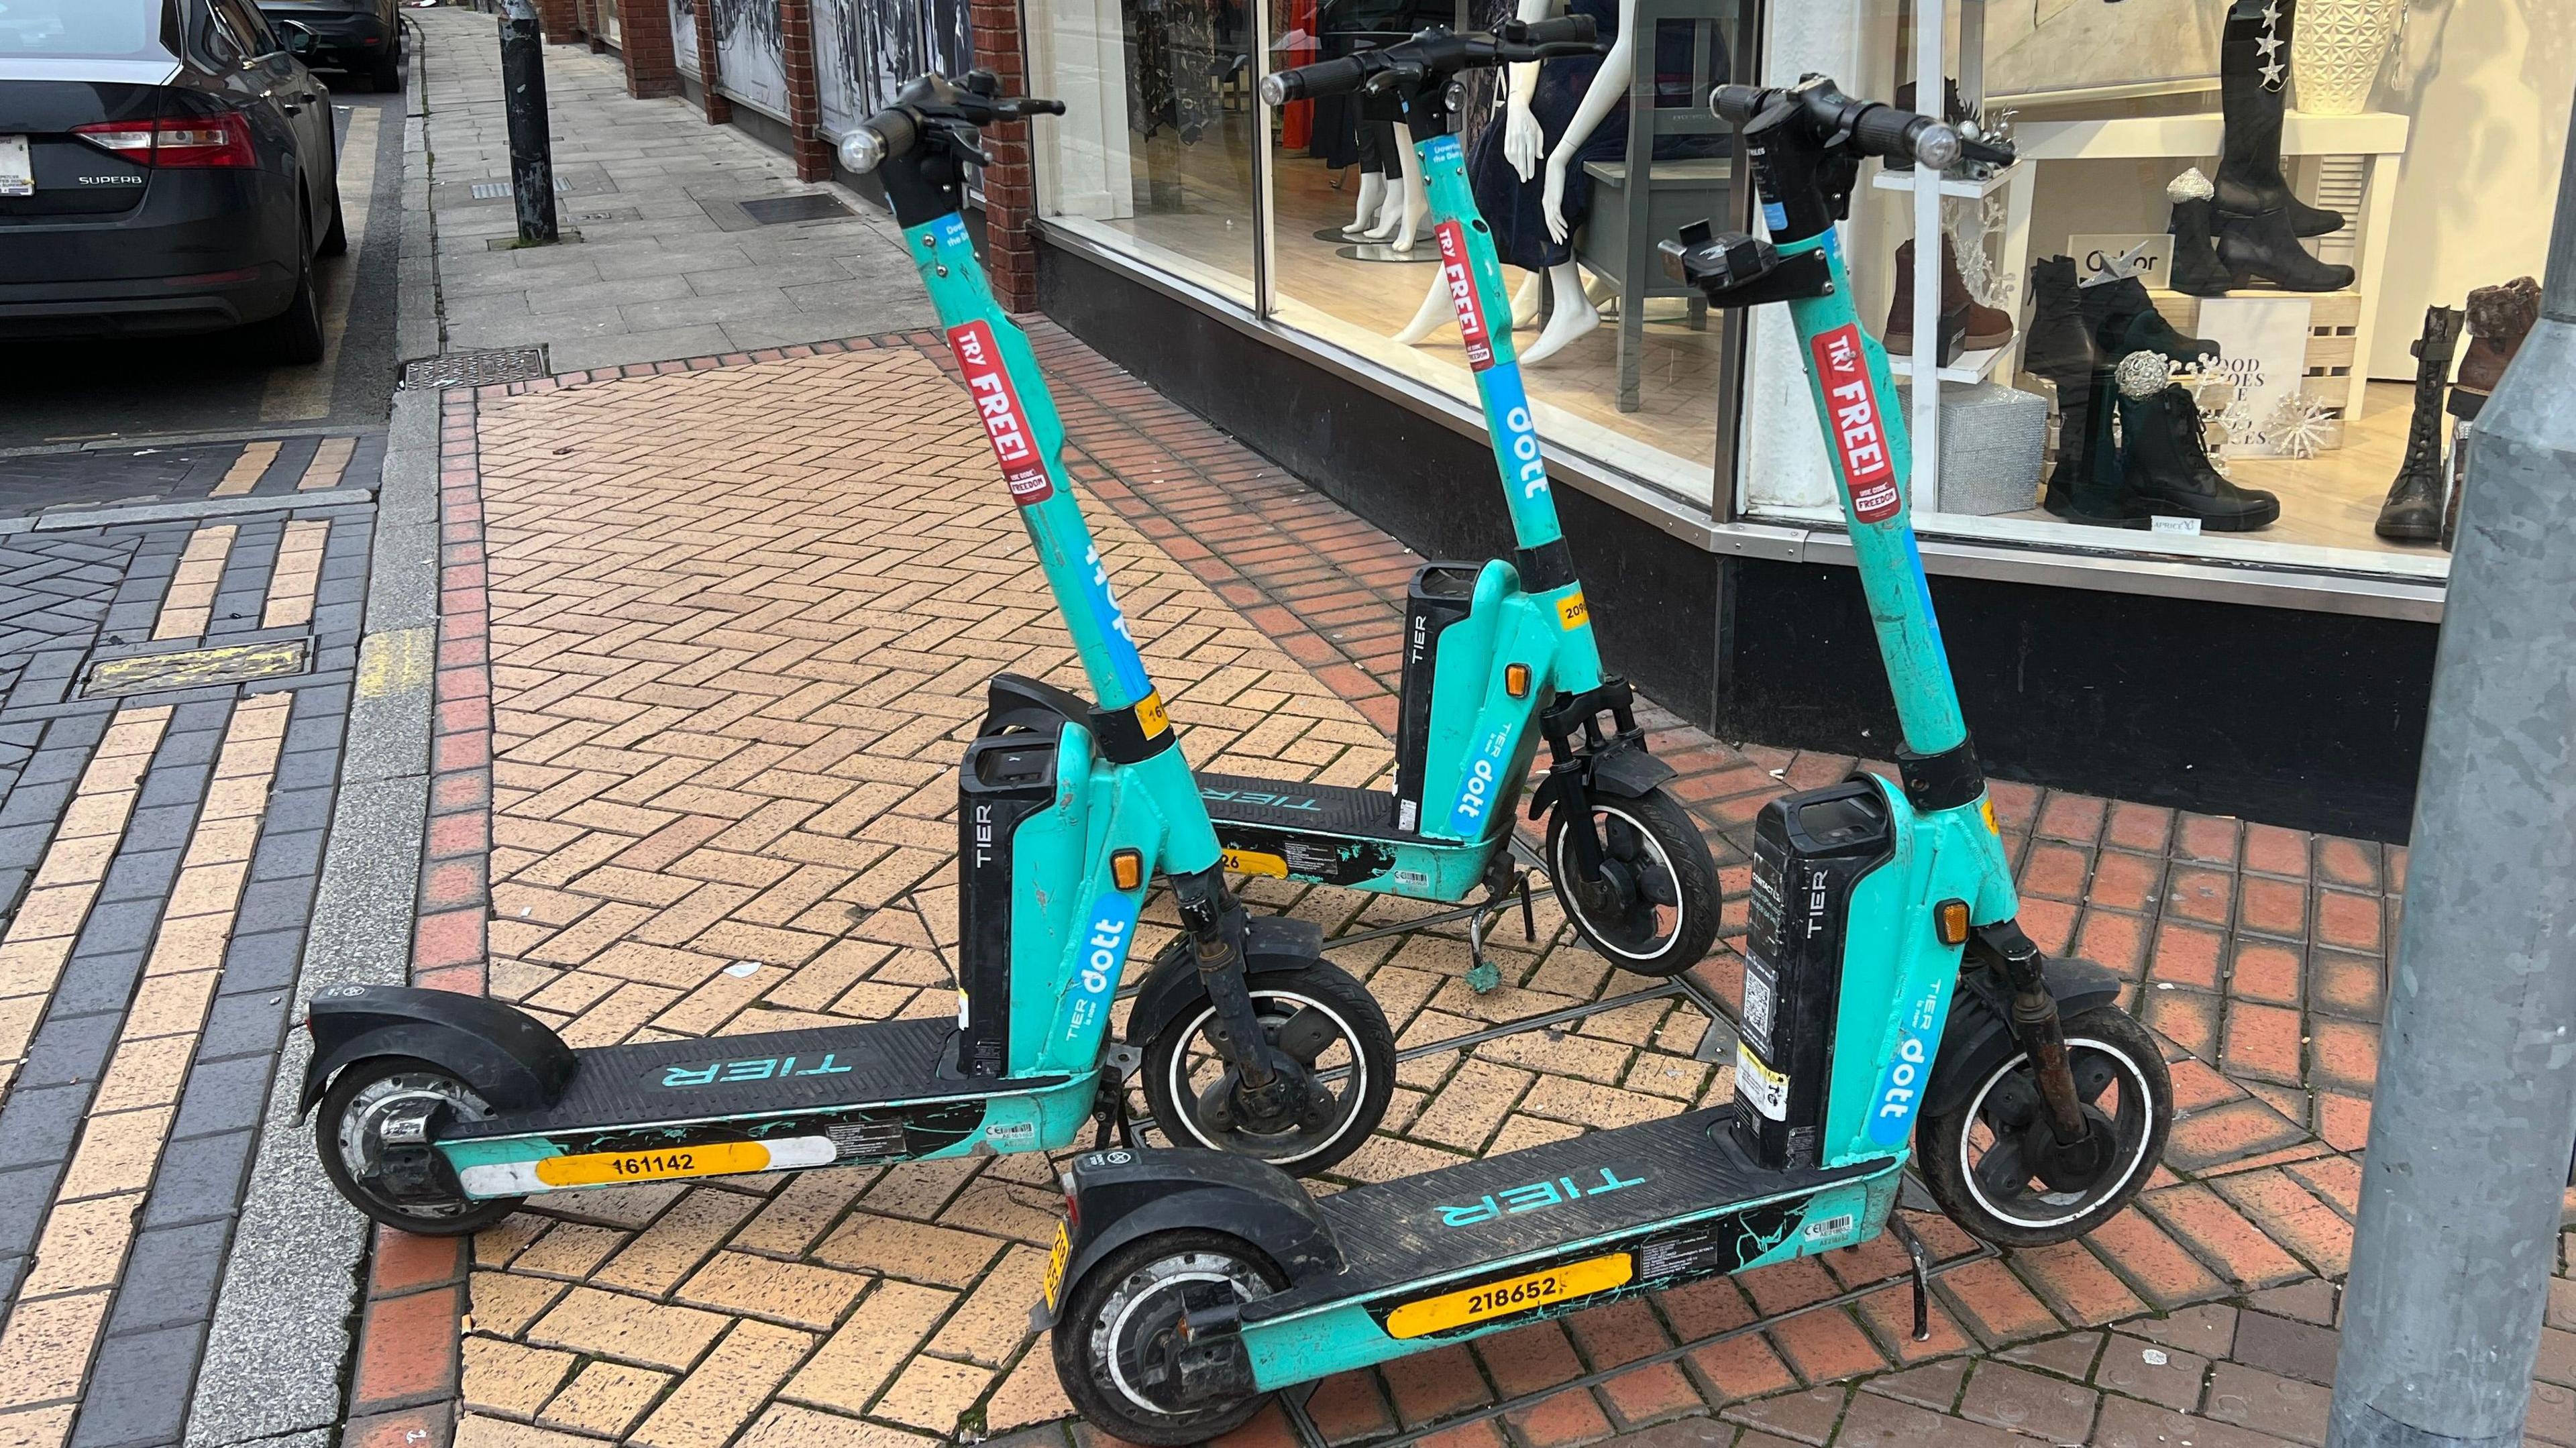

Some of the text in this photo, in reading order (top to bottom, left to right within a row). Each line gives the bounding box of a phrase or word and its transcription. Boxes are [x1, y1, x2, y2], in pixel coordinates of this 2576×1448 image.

[78, 176, 143, 185] SUPERB
[1438, 228, 1480, 336] TRY FREE!
[1828, 335, 1856, 373] TRY
[958, 331, 1030, 462] TRY FREE!
[1832, 380, 1885, 476] FREE!
[1506, 406, 1548, 499] dott
[1012, 477, 1044, 492] FREEDOM
[1858, 490, 1894, 509] FREEDOM
[1411, 616, 1427, 665] TIER
[1490, 722, 1512, 759] TIER
[1202, 787, 1322, 812] TIER
[1457, 759, 1494, 819] dott
[976, 805, 992, 869] TIER
[1807, 869, 1829, 939] TIER
[1081, 918, 1126, 994] dott
[1065, 998, 1088, 1042] TIER
[1087, 1001, 1097, 1018] now
[1912, 1010, 1921, 1029] now
[1919, 979, 1941, 1030] TIER
[661, 1053, 853, 1087] TIER
[1879, 1038, 1925, 1119] dott
[612, 1154, 695, 1175] 161142
[1434, 1167, 1646, 1228] TIER
[1054, 1229, 1066, 1268] 218
[1047, 1258, 1059, 1299] 652
[1467, 1277, 1556, 1315] 218652
